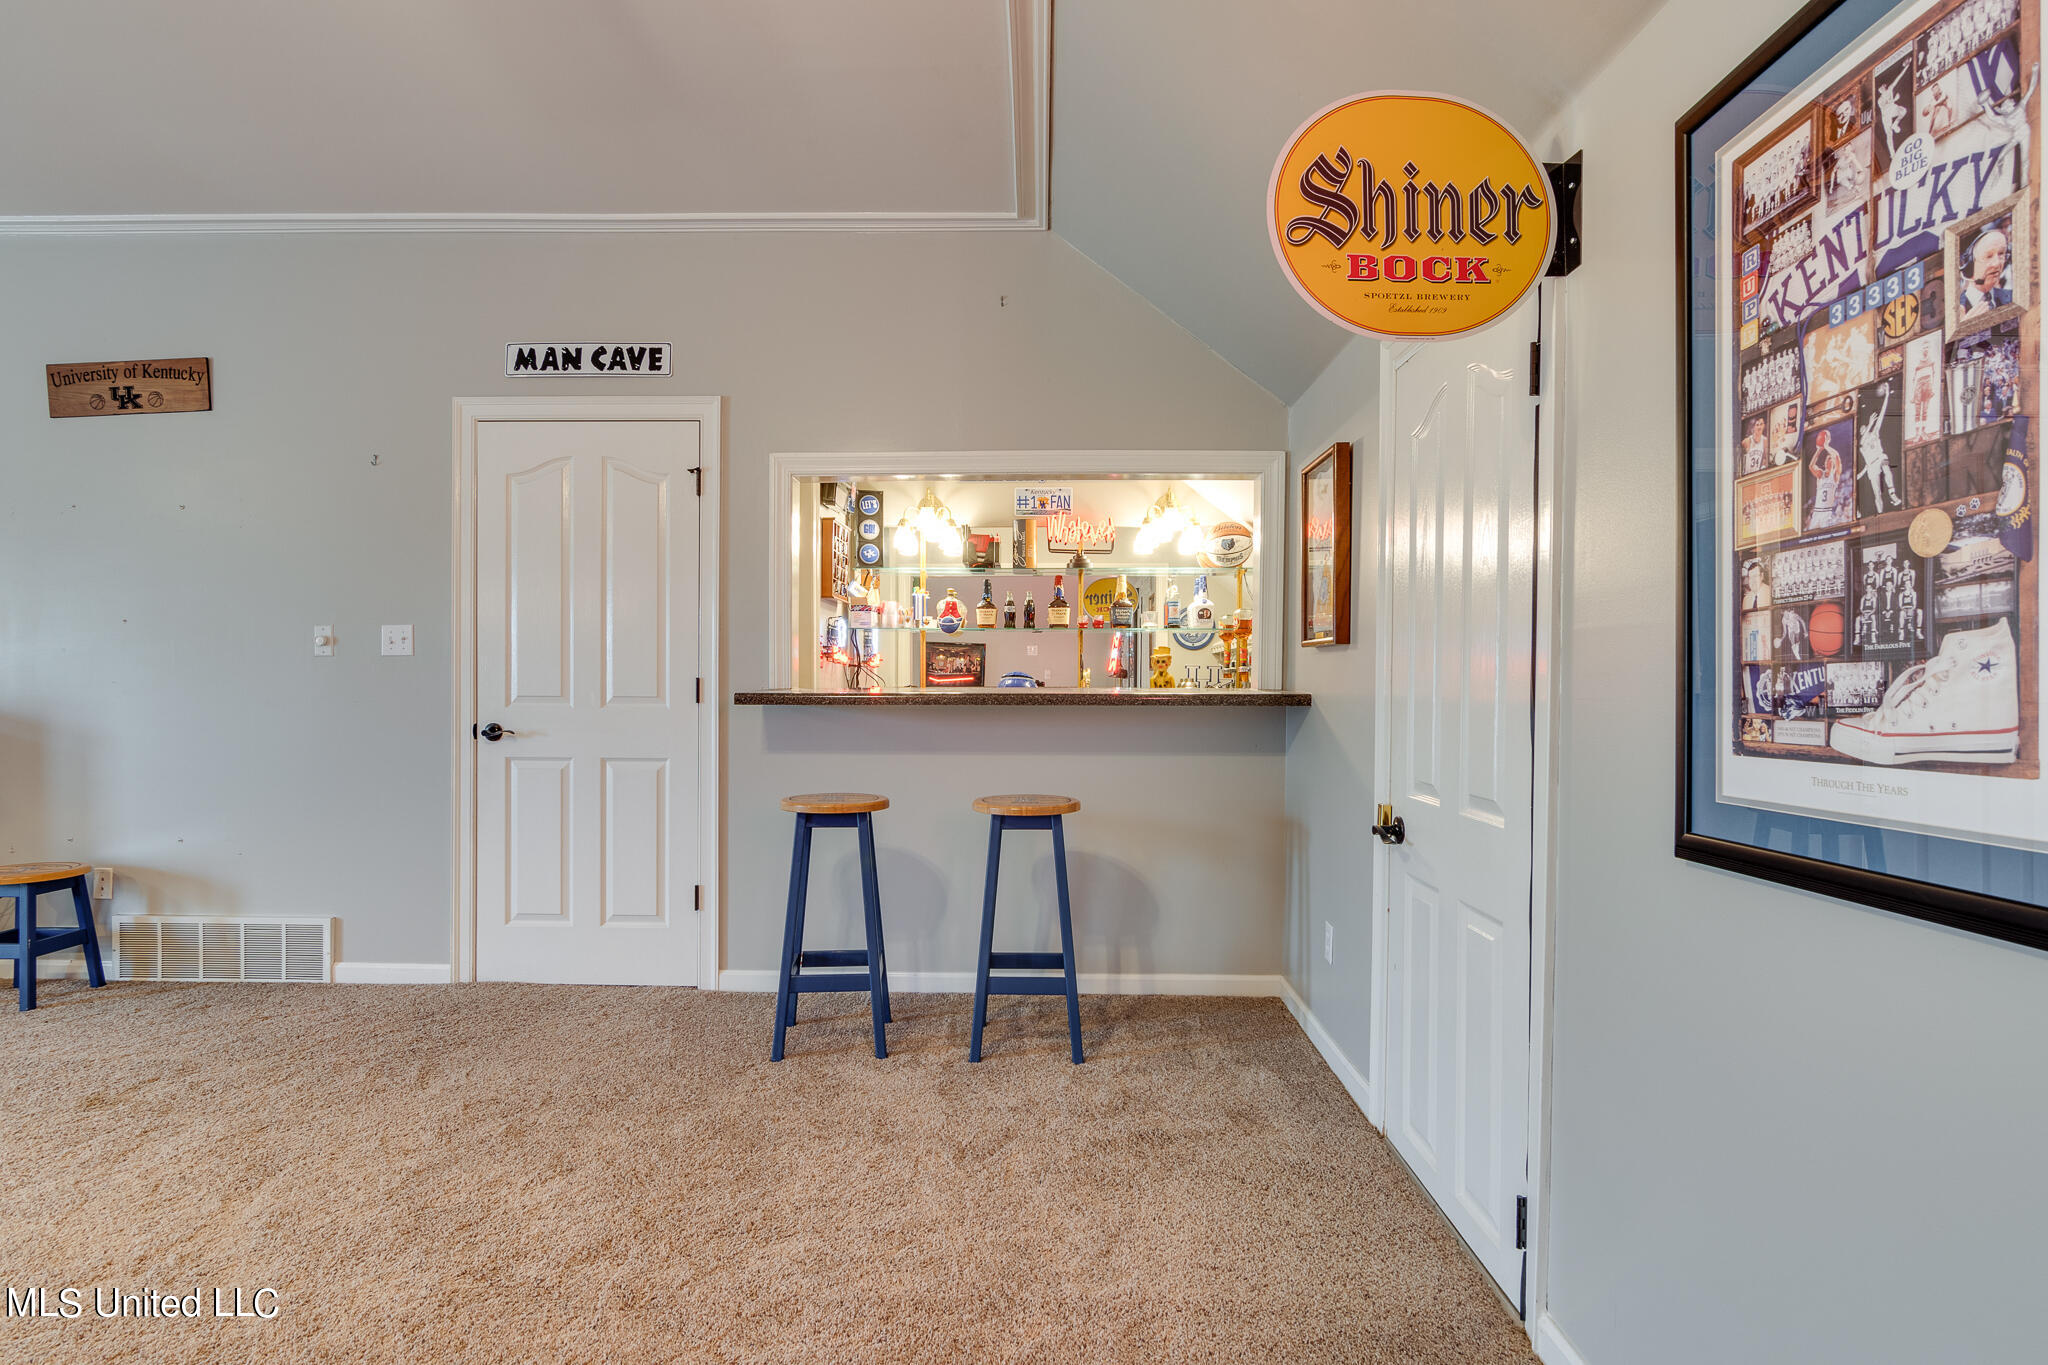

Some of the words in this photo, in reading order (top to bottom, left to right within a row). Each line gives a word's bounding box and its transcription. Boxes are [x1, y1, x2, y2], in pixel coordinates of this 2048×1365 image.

[1904, 138, 1923, 154] GO
[1895, 157, 1929, 181] BLUE
[1901, 149, 1922, 168] BIG
[1285, 144, 1543, 249] Shiner
[1346, 253, 1491, 284] BOCK
[1363, 292, 1412, 300] SPOETZL
[1417, 293, 1471, 301] BREWERY
[1388, 302, 1430, 313] Established
[1429, 306, 1448, 314] 1909
[1884, 294, 1919, 336] SEC
[513, 346, 582, 371] MAN
[590, 346, 663, 371] CAVE
[50, 365, 119, 388] University
[124, 363, 139, 379] of
[142, 363, 205, 385] Kentucky
[108, 385, 143, 409] UK
[1050, 495, 1071, 509] FAN
[1811, 776, 1854, 791] THROUGH
[1855, 781, 1875, 793] THE
[1877, 783, 1909, 796] YEARS
